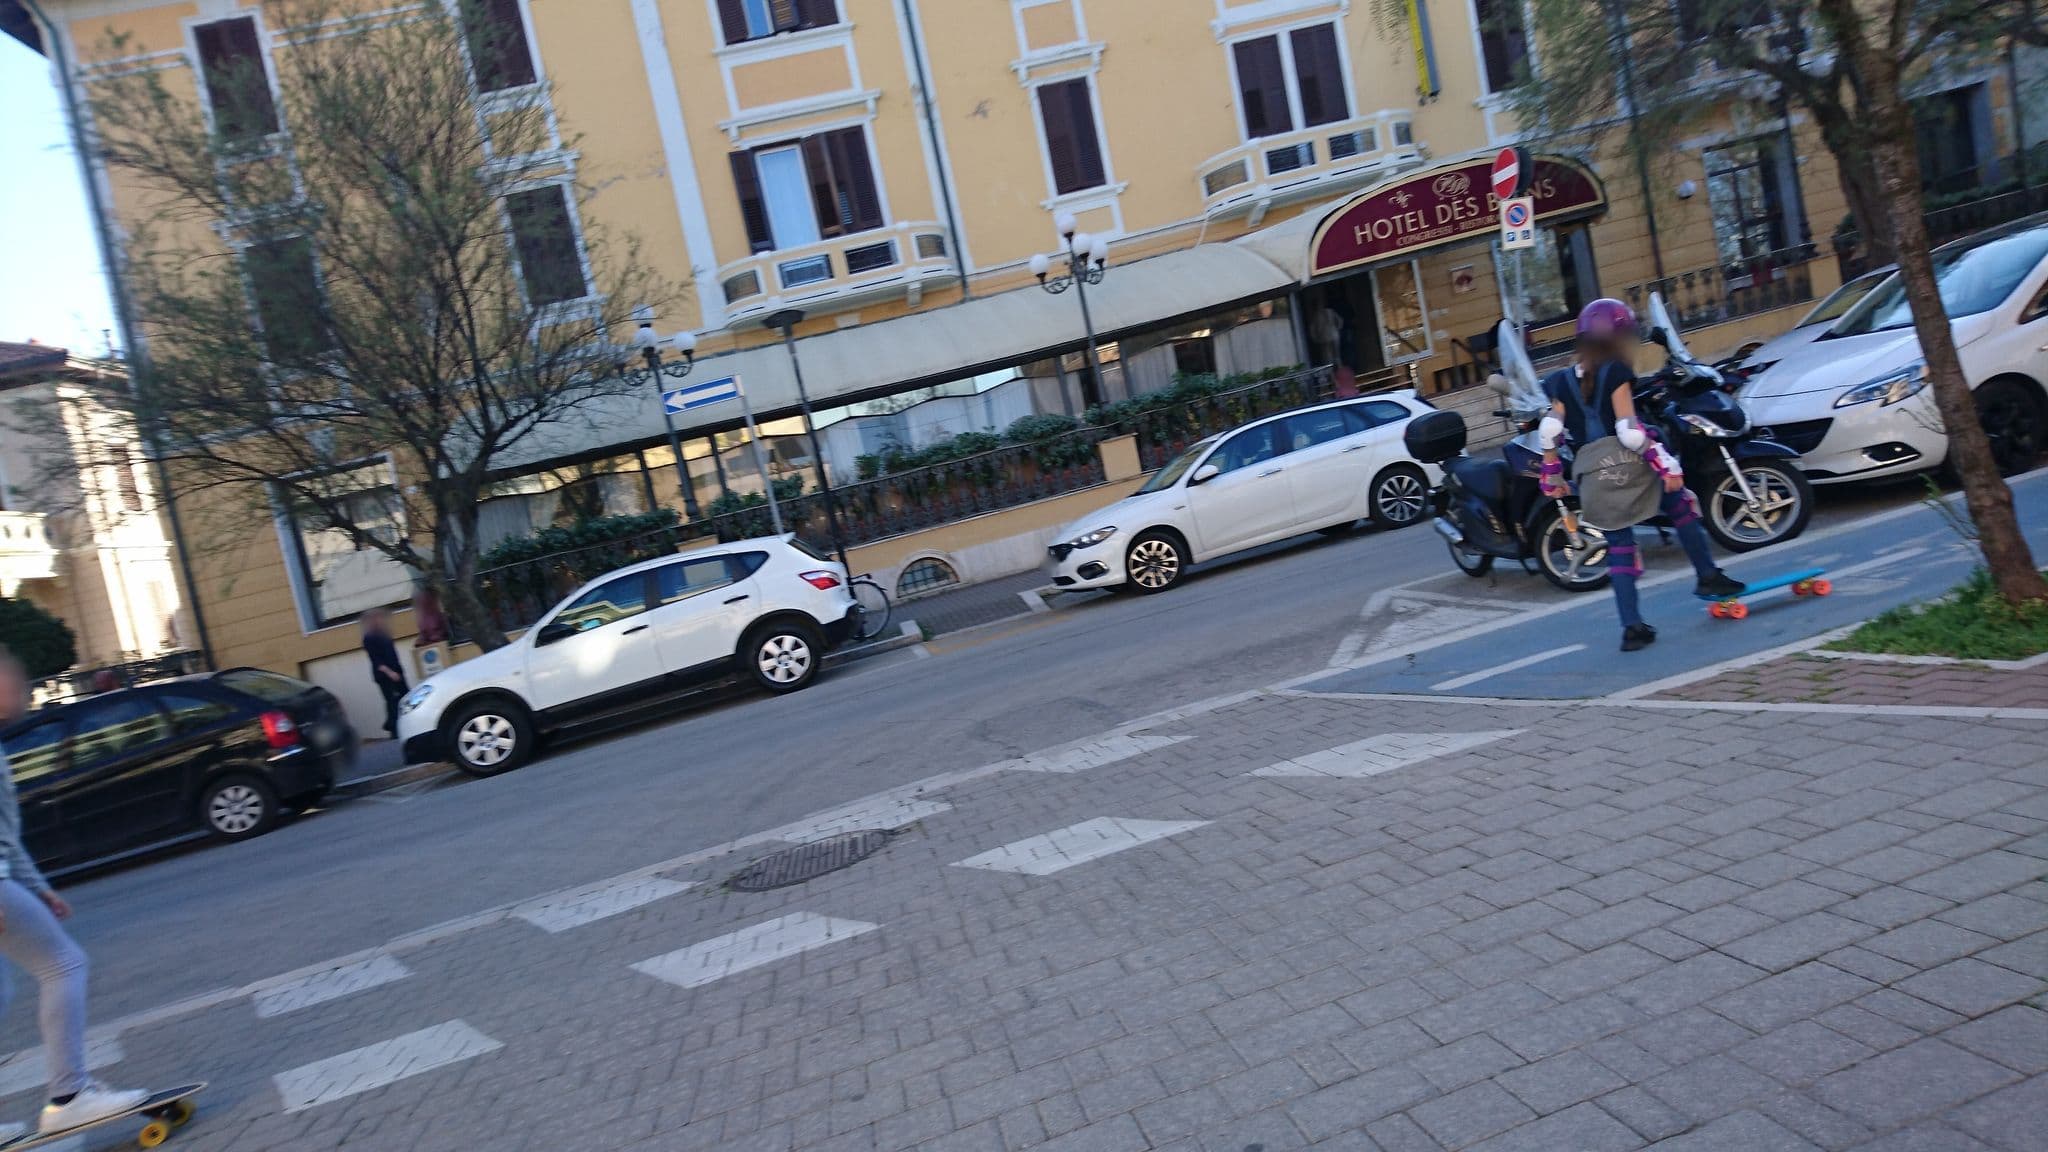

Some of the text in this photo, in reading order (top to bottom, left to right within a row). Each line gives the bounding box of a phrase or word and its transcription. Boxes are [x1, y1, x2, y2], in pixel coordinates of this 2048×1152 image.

[1354, 211, 1430, 245] HOTEL
[1436, 198, 1479, 224] DES
[1488, 178, 1556, 212] BNS
